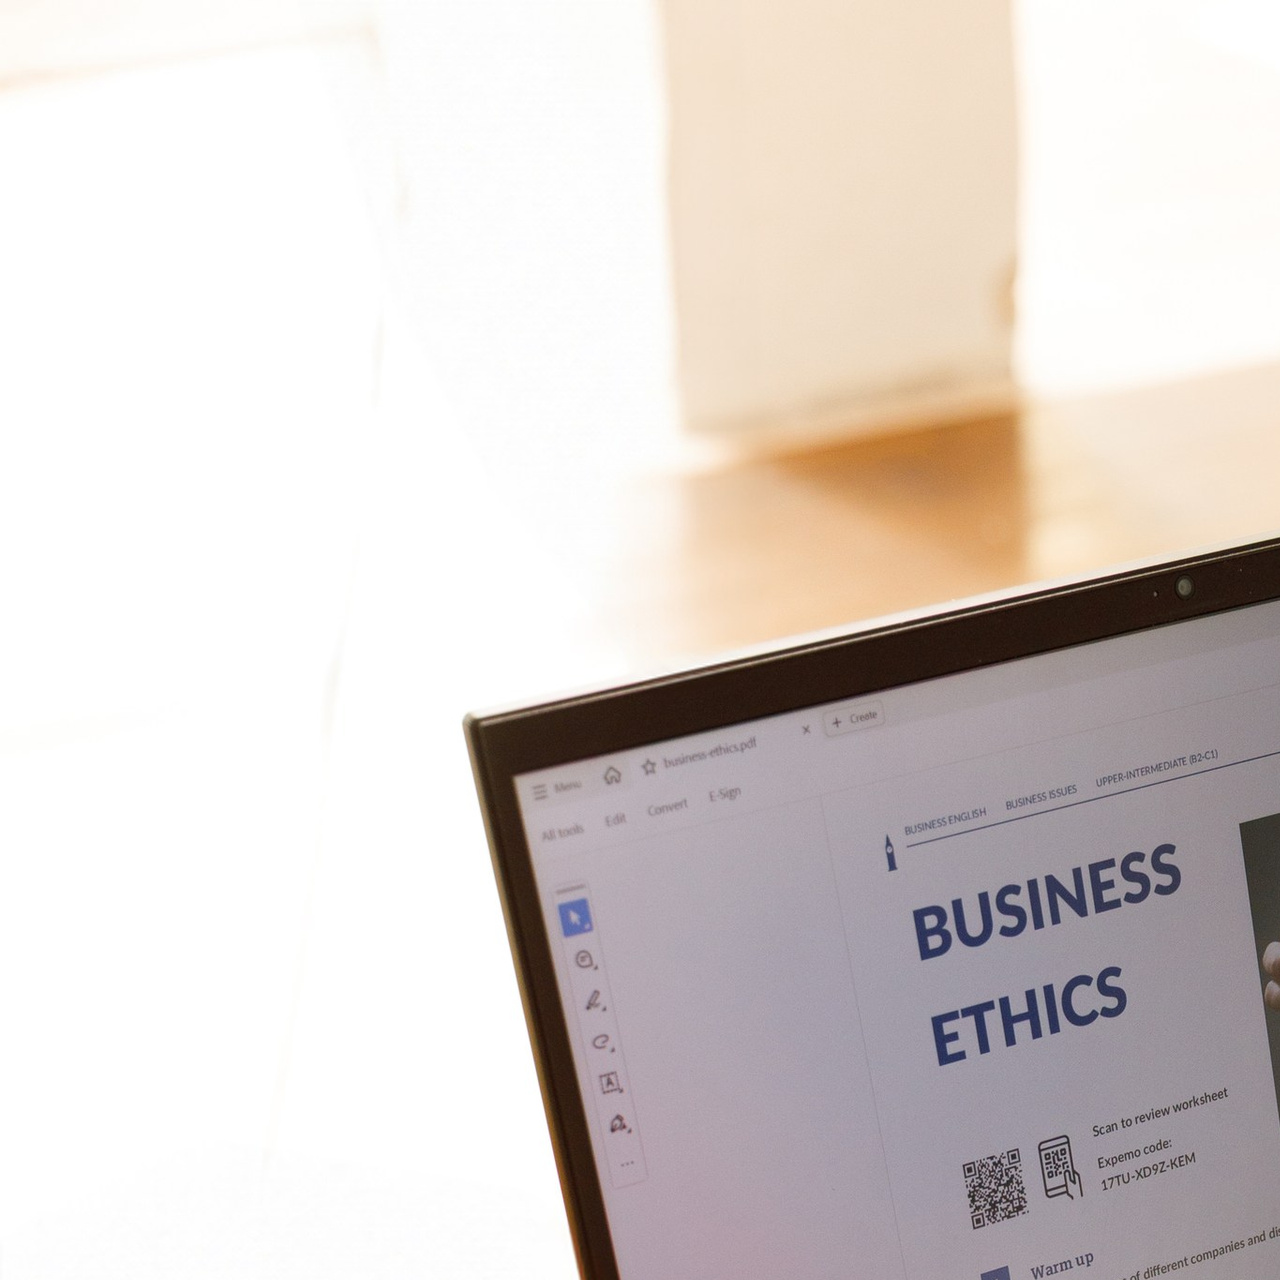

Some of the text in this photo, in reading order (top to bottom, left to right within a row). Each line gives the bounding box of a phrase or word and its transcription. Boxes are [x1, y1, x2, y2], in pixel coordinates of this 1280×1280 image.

[850, 709, 878, 724] Create
[664, 736, 757, 769] business-ethics.pdf
[1096, 749, 1218, 787] UPPER-INTERMEDIATE (B2-C1)
[554, 779, 582, 794] Menu
[709, 785, 741, 802] E-Sign
[1006, 784, 1077, 810] BUSINESS ISSUES
[605, 812, 626, 827] Edit
[648, 798, 688, 817] Convert
[904, 807, 987, 835] BUSINESS ENGLISH
[542, 823, 584, 841] All tools
[912, 844, 1182, 960] BUSINESS
[930, 966, 1128, 1066] ETHICS
[1092, 1088, 1229, 1137] Scan to review worksheet
[1098, 1138, 1172, 1169] Expemo code:
[1101, 1152, 1196, 1191] 17TU-XD9Z-KEM
[1031, 1253, 1094, 1280] Warm up
[1143, 1258, 1189, 1280] different
[1191, 1241, 1245, 1264] companies
[1248, 1231, 1266, 1246] and
